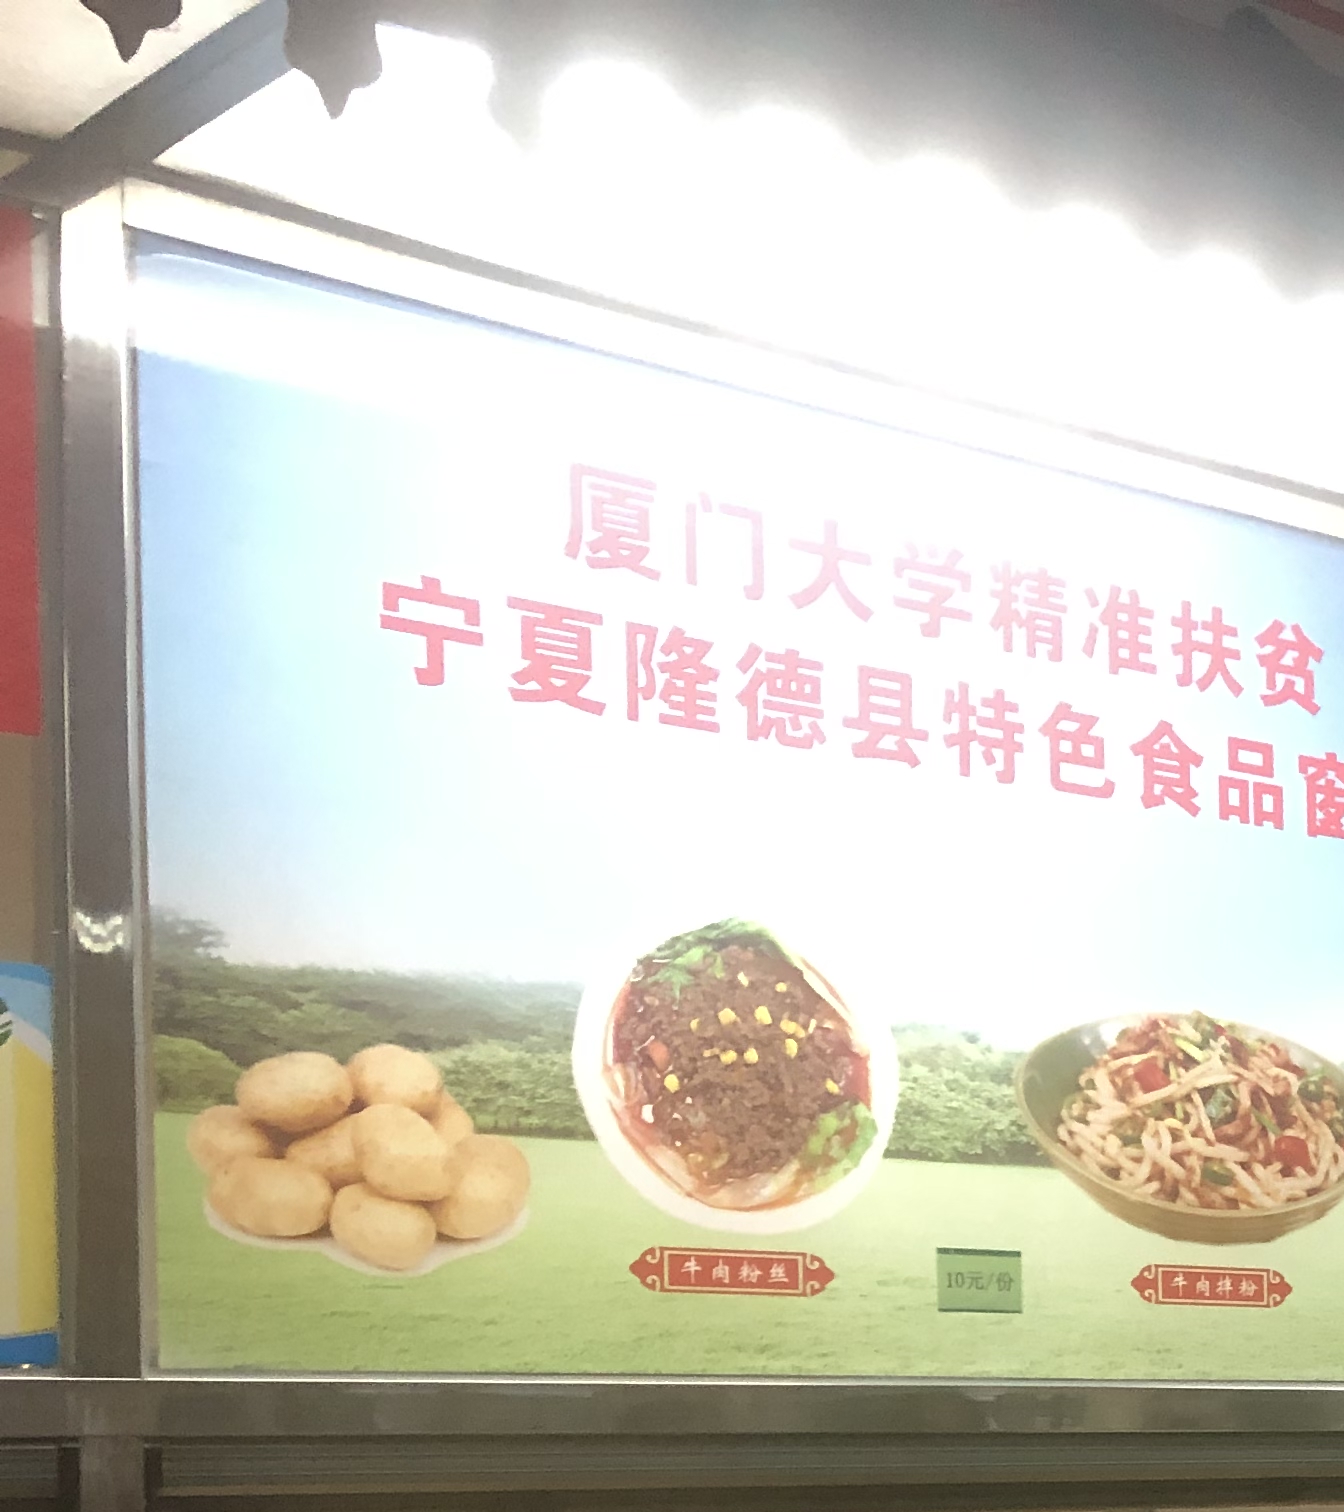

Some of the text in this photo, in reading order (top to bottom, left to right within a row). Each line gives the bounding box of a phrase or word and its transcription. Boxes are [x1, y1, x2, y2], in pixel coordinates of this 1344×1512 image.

[564, 461, 1325, 717] 厦门大学精准扶贫
[680, 1256, 790, 1285] 牛肉粉丝
[945, 1270, 1014, 1294] 10元/份
[1168, 1272, 1260, 1299] 牛肉拌粉
